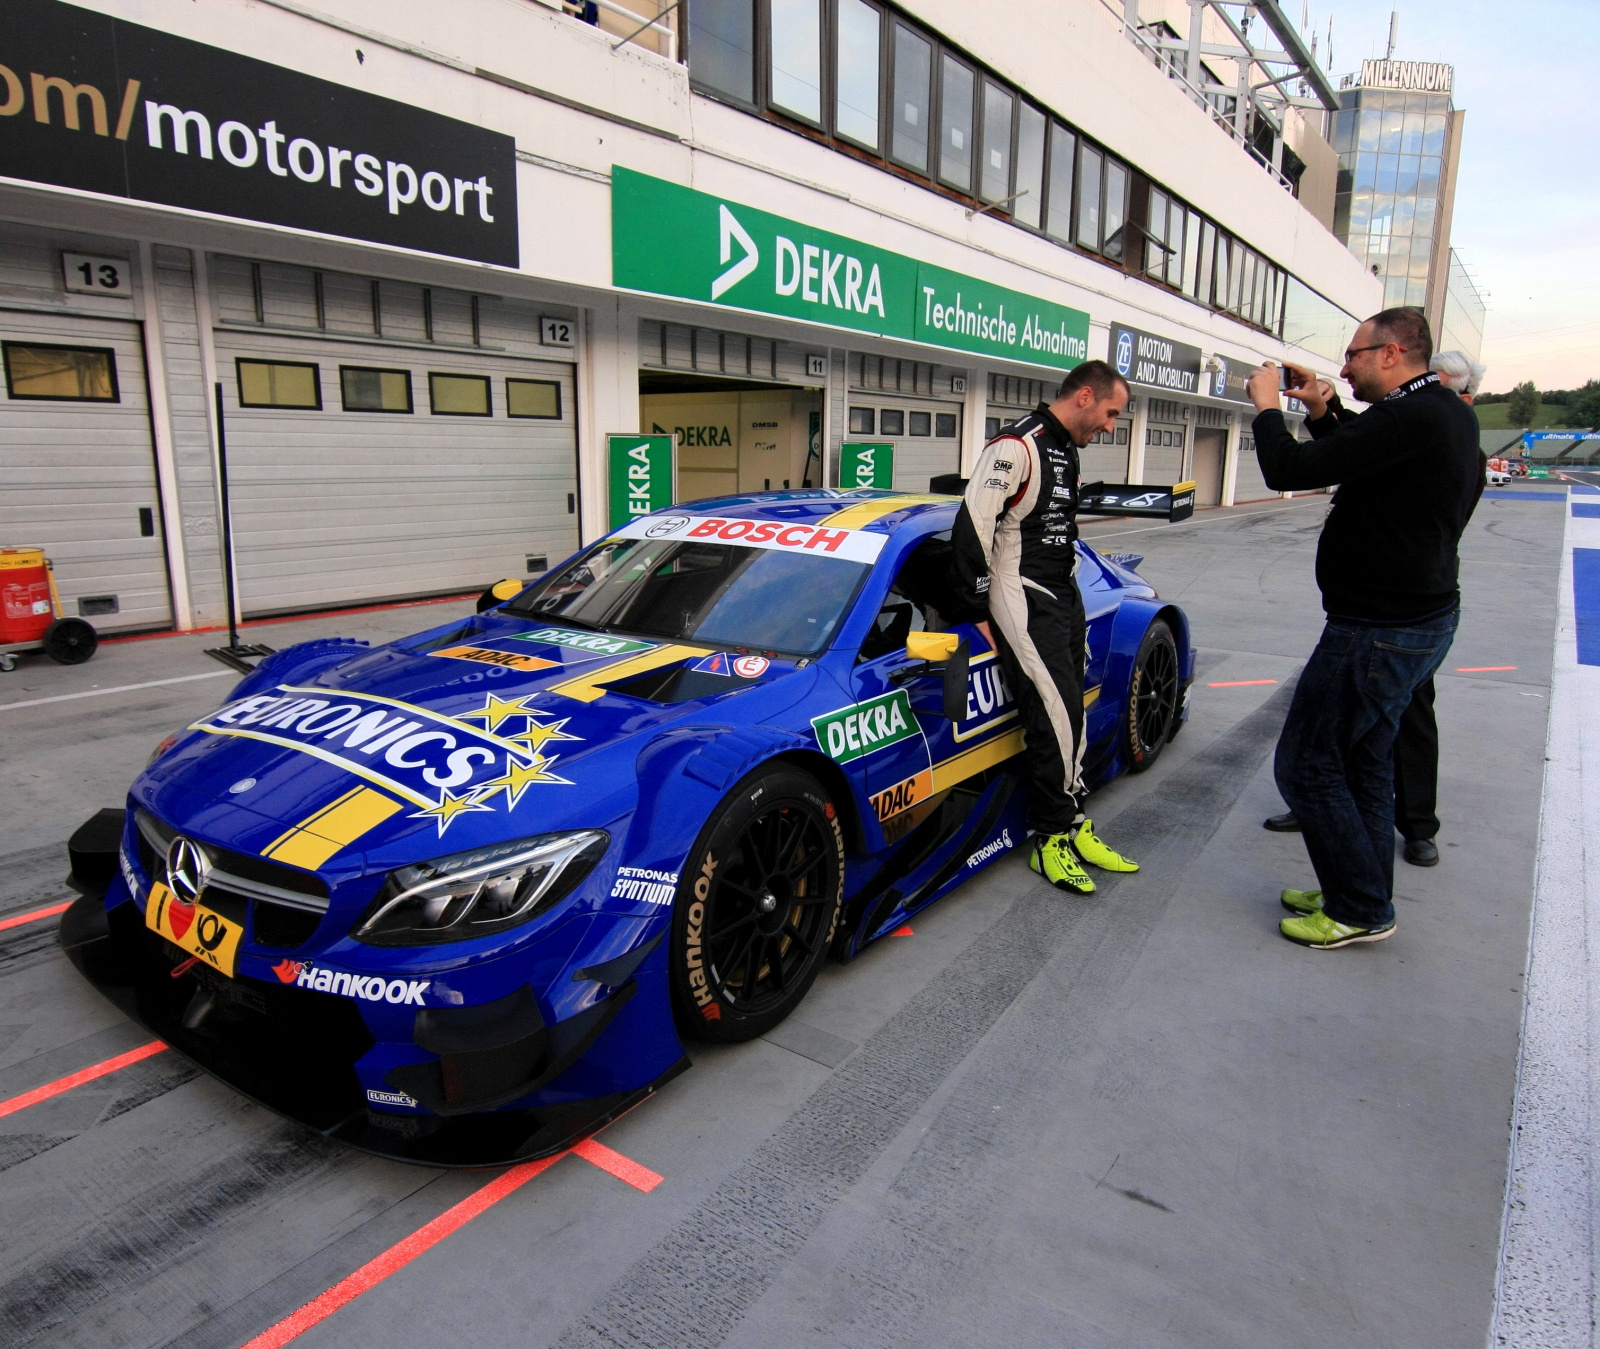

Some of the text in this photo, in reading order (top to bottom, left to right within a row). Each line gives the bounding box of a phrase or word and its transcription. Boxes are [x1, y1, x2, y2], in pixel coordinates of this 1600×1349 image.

[1360, 58, 1450, 92] MILLENNIUM
[76, 261, 120, 289] 13
[775, 234, 886, 319] DEKRA
[547, 323, 570, 343] 12
[923, 286, 1087, 360] Technische Abnahme
[1137, 335, 1173, 364] MOTION
[811, 360, 823, 373] 11
[1135, 361, 1195, 392] AND MOBILITY
[954, 379, 963, 392] 10
[674, 425, 732, 447] DEKRA
[993, 461, 1013, 471] OMP
[628, 443, 651, 521] EKRA
[1172, 496, 1190, 509] PETRONAS
[686, 519, 849, 552] BOSCH
[533, 629, 628, 654] DEKRA
[459, 650, 530, 667] ADAC
[217, 694, 496, 788] EURONICS
[827, 699, 908, 759] DEKRA
[966, 838, 1004, 869] PETRONAS
[617, 866, 679, 884] PETRONAS
[610, 879, 677, 906] SYNTIUM
[369, 1092, 412, 1104] EURONICS
